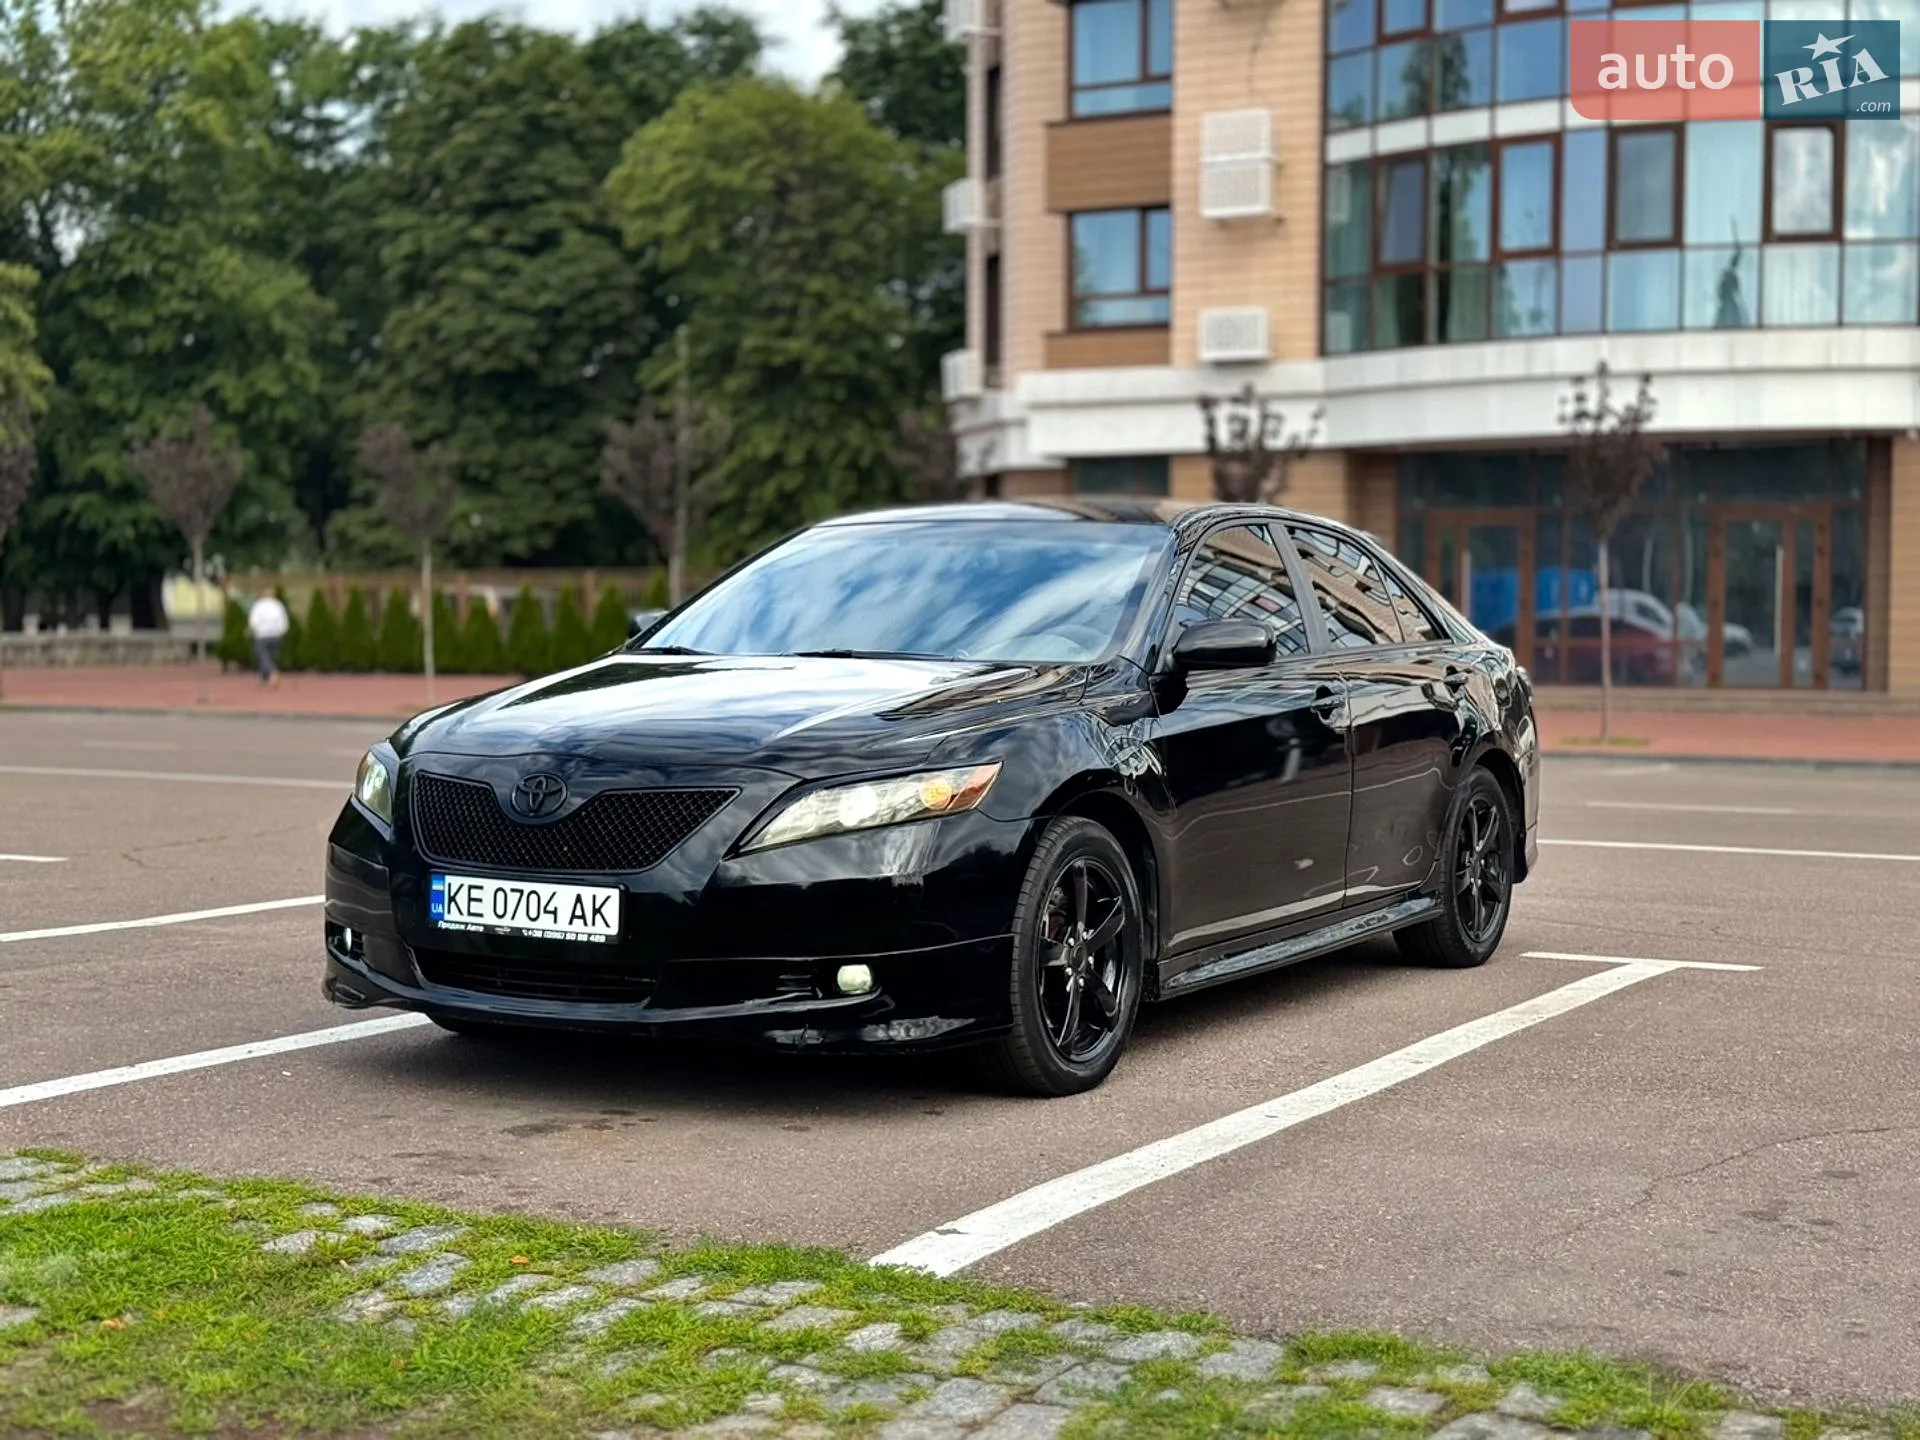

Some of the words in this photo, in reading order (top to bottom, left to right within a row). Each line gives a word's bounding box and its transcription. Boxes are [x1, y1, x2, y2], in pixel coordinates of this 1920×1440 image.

[431, 903, 444, 914] UA
[446, 882, 484, 918] KE
[493, 886, 558, 925] 0704
[568, 893, 612, 929] AK
